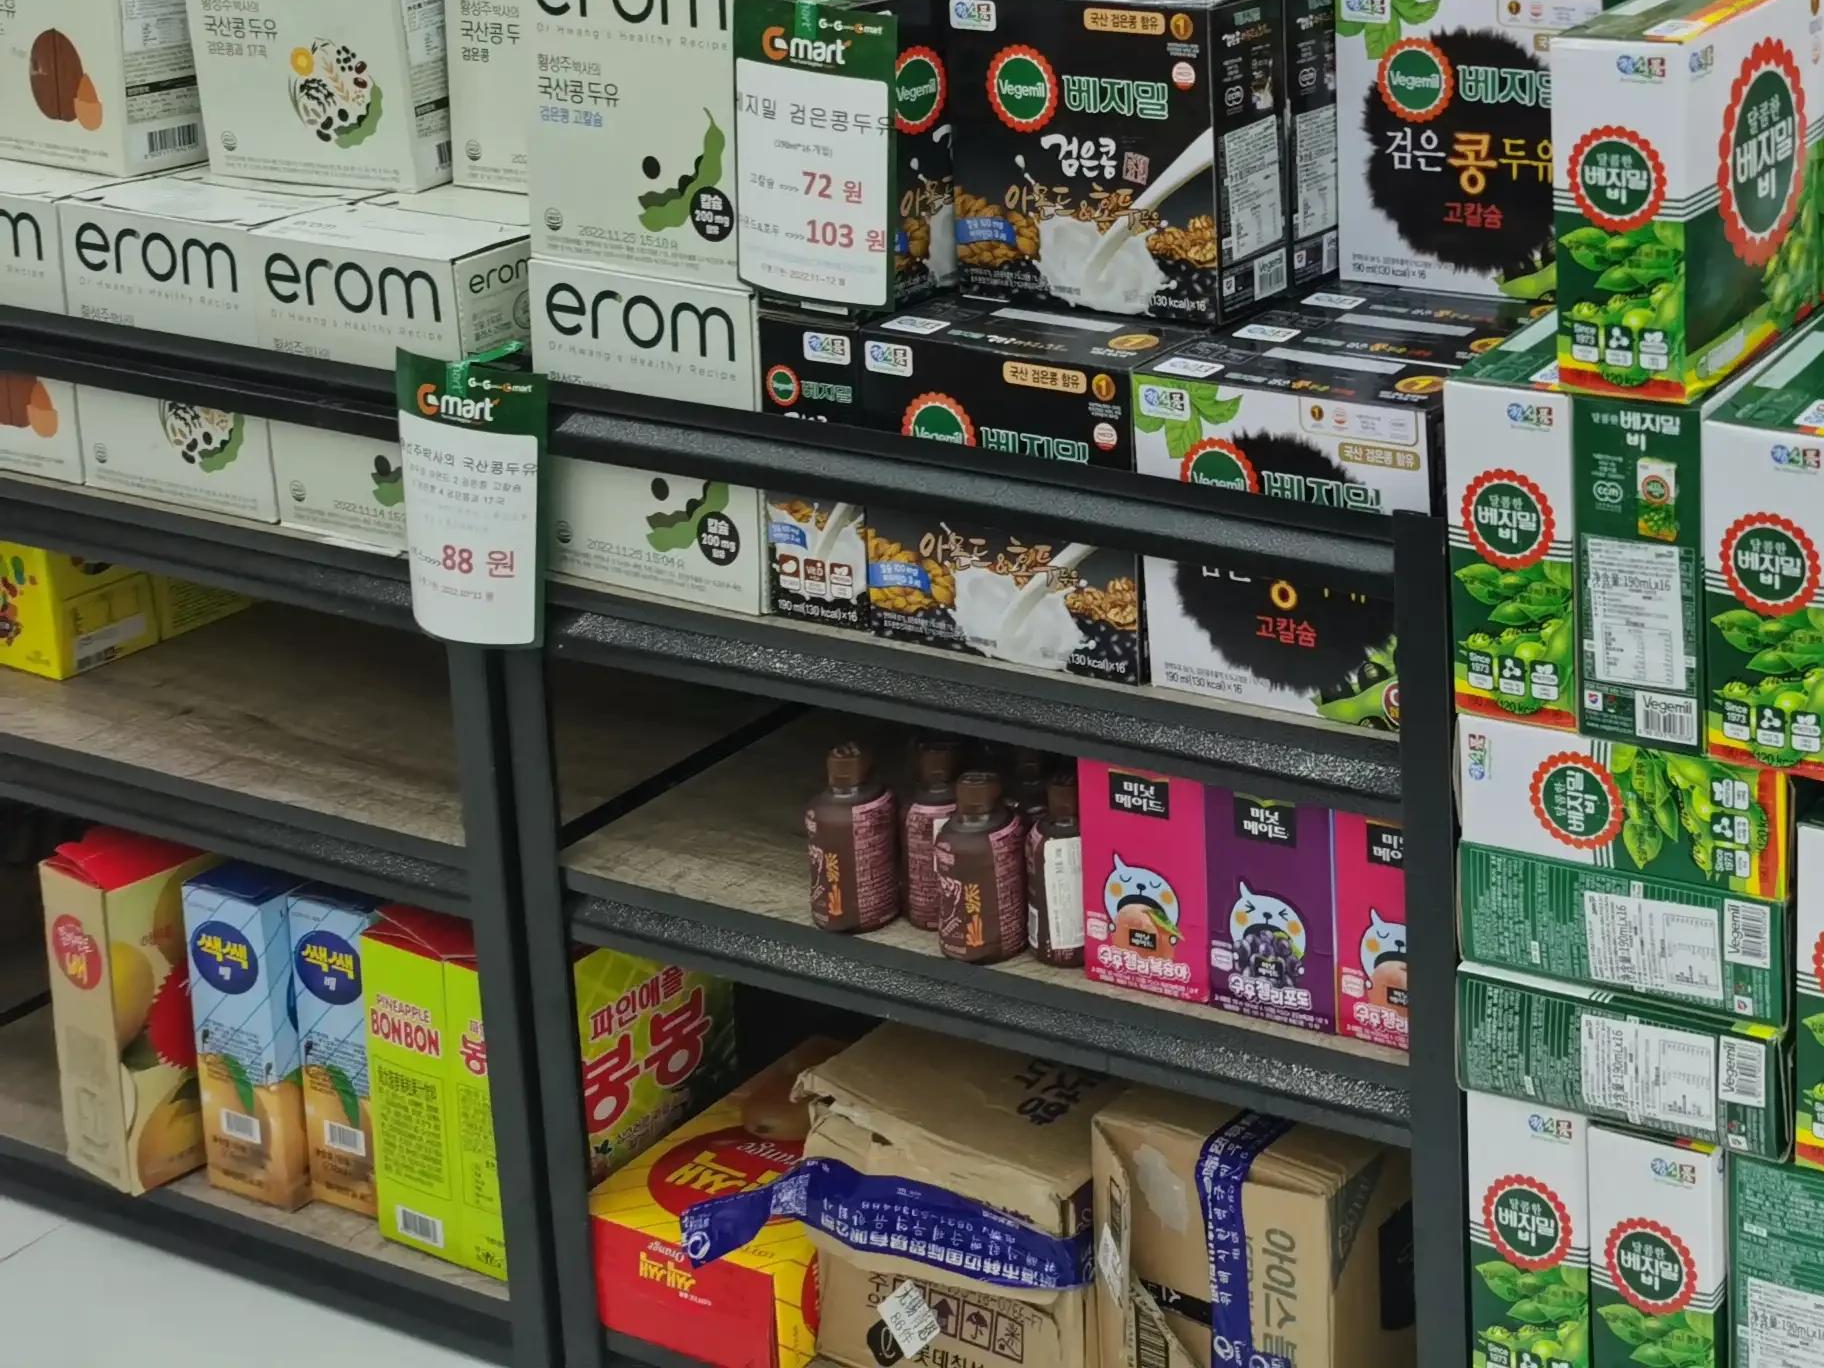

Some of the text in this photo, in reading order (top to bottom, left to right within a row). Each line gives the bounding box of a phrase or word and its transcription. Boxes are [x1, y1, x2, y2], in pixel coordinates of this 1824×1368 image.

[203, 15, 278, 41] 국산콩 두유
[1090, 12, 1109, 28] 국산
[679, 38, 729, 52] Recipe
[762, 25, 854, 65] Gmart
[537, 76, 620, 109] 국산콩 두유
[997, 78, 1047, 99] Vegemil
[1389, 69, 1441, 91] Vegemil
[1062, 74, 1169, 120] 베지밀
[538, 104, 569, 123] 검은콩
[1040, 132, 1118, 179] 검은콩
[1736, 116, 1793, 184] 베지밀
[802, 170, 864, 205] 72 원
[1583, 164, 1649, 192] 베지밀
[1756, 167, 1777, 200] 비
[699, 194, 724, 212] 칼슘
[1606, 188, 1628, 206] 비
[694, 209, 730, 228] 200 mg
[1443, 202, 1505, 230] 고칼슘
[806, 219, 886, 254] 103 원
[76, 222, 238, 293] erom
[265, 252, 442, 323] erom
[399, 328, 444, 343] Recipe
[546, 282, 736, 362] erom
[629, 353, 737, 382] Healthy Recipe
[1008, 365, 1029, 382] 국산
[416, 383, 501, 423] Gmart
[1343, 444, 1364, 461] 국산
[707, 517, 730, 535] 칼슘
[1477, 504, 1538, 532] 베지밀
[700, 532, 737, 552] 200 mg
[1498, 525, 1519, 545] 비
[442, 543, 474, 575] 88
[486, 548, 516, 579] 원
[1737, 548, 1802, 578] 베지밀
[1758, 571, 1781, 591] 비
[778, 598, 793, 613] 190
[1255, 615, 1318, 649] 고칼슘
[1468, 651, 1491, 666] Since
[1470, 661, 1491, 675] 1973
[1165, 670, 1180, 684] 190
[1642, 694, 1694, 715] Vegemil
[1724, 701, 1749, 716] Since
[1725, 710, 1748, 725] 1973
[1114, 793, 1166, 813] 메이드
[1122, 780, 1156, 799] 미닛
[1243, 819, 1288, 840] 메이드
[1249, 807, 1280, 825] 미닛
[1714, 850, 1727, 873] Since
[1727, 903, 1742, 954] Vegemil
[197, 933, 249, 970] 쌕쌕
[302, 943, 355, 981] 쌕쌕
[375, 992, 432, 1024] PINEAPPLE
[590, 966, 685, 1041] 파인애플
[584, 987, 712, 1133] 봉봉
[1721, 1042, 1738, 1093] Vegemil
[1497, 1206, 1555, 1237] 베지밀
[647, 1240, 686, 1264] Orange
[639, 1251, 697, 1292] 쌕쌕
[1619, 1251, 1680, 1281] 베지밀
